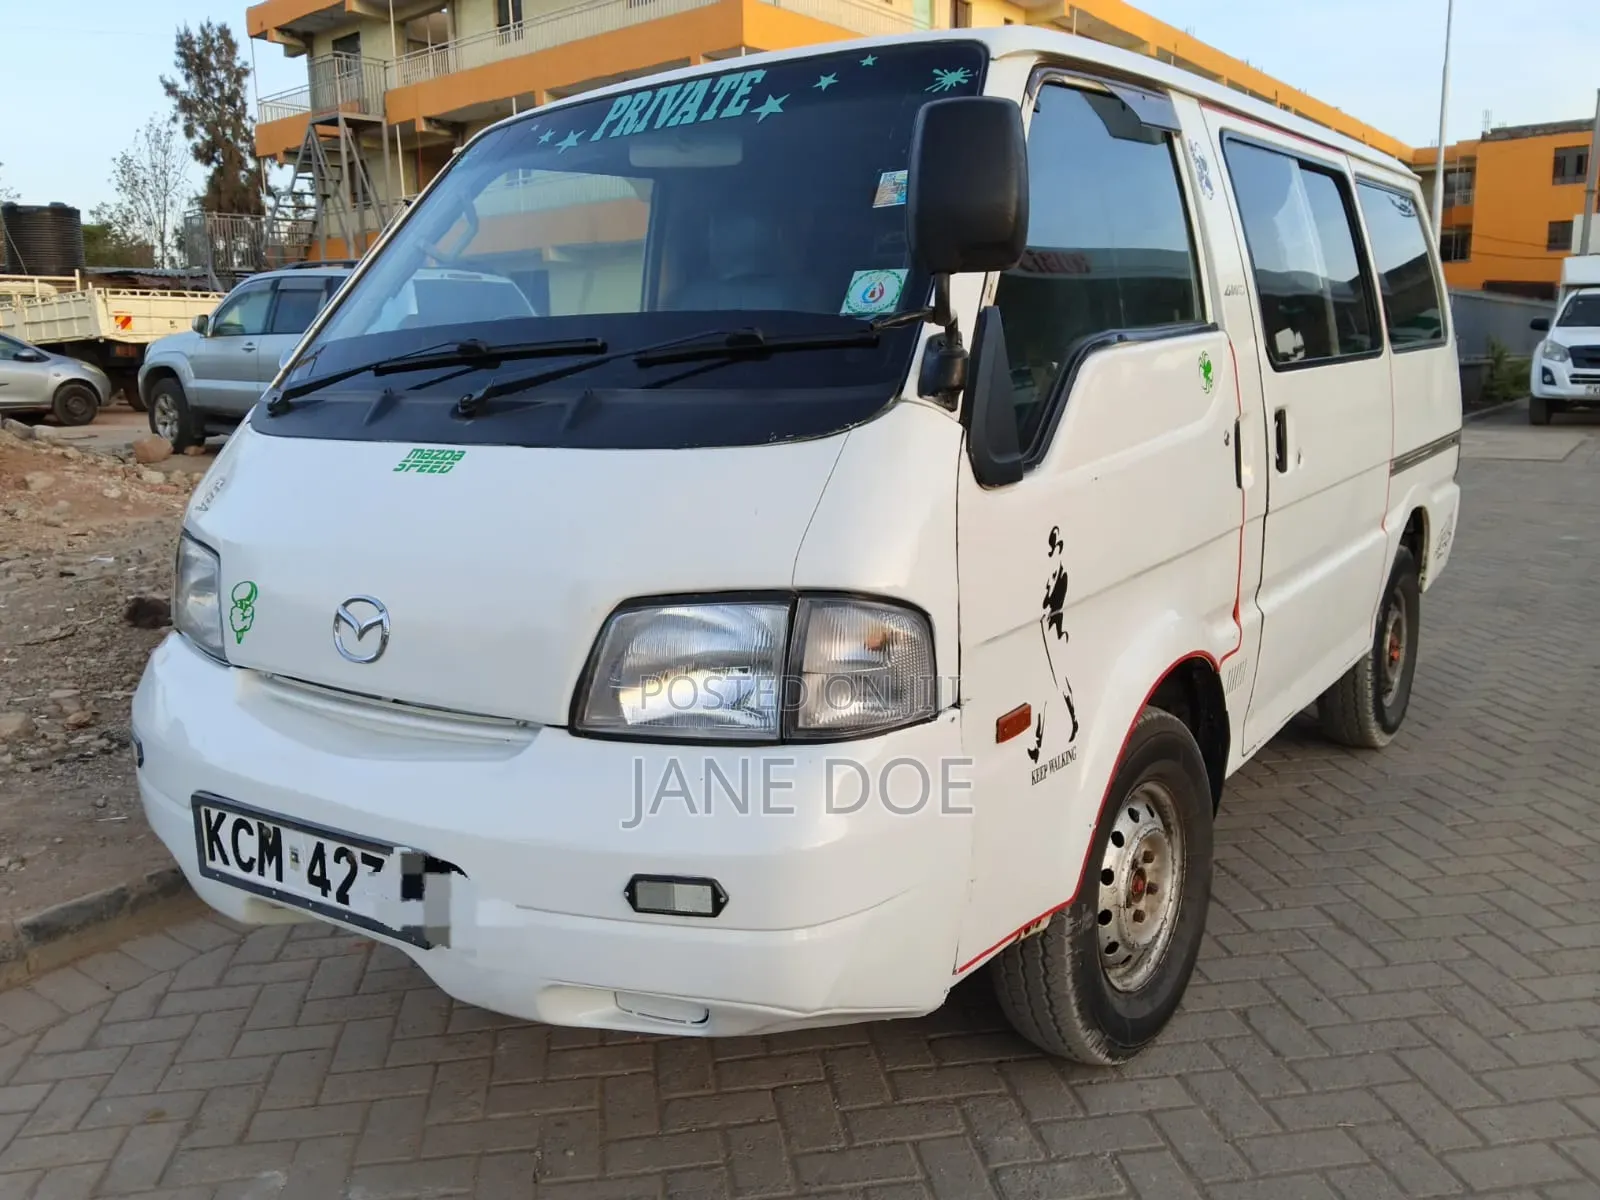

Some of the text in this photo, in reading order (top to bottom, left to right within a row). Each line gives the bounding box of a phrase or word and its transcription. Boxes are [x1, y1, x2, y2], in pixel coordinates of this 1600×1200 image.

[589, 69, 767, 142] PRIVATE
[392, 459, 455, 474] SPEED
[1031, 745, 1077, 786] KEEP WALKING
[204, 807, 284, 883] KCM
